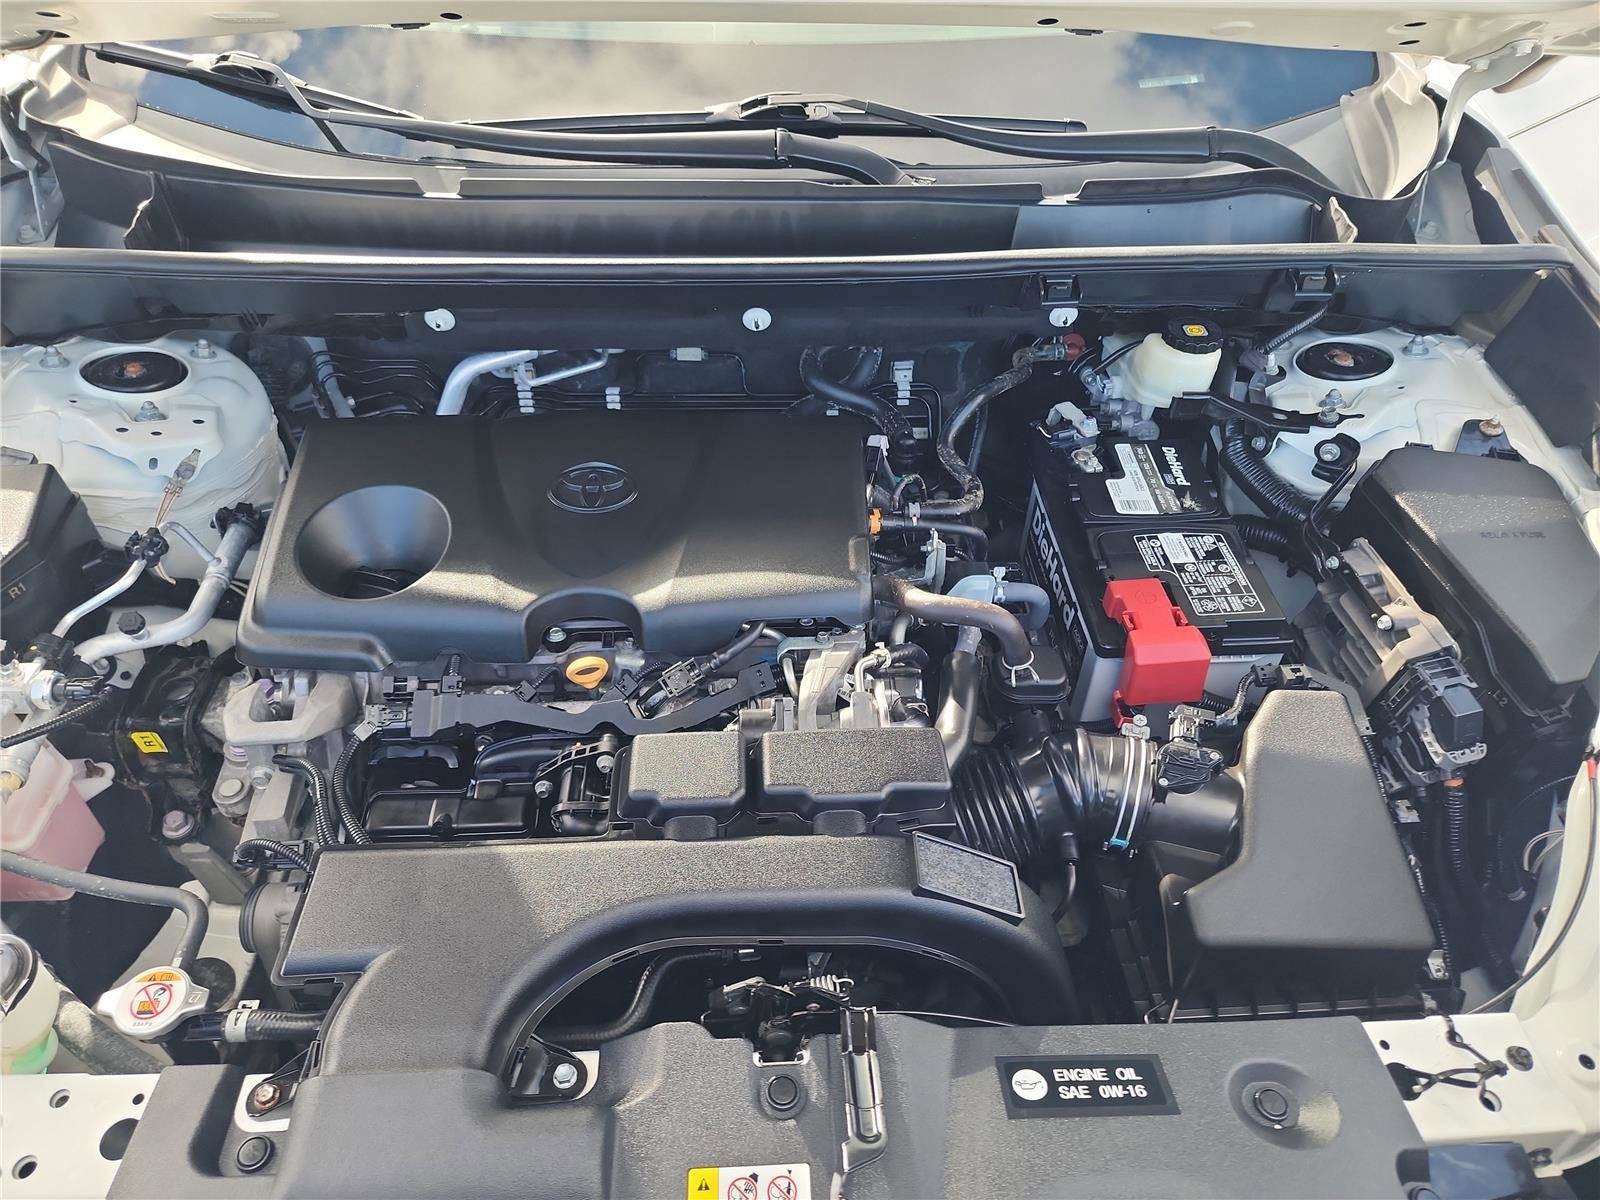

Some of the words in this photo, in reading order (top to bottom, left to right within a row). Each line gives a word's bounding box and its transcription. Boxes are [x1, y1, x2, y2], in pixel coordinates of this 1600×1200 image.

[1161, 446, 1192, 486] DieHard
[1032, 505, 1075, 631] DieHard
[8, 582, 26, 599] R1
[1052, 1068, 1110, 1082] ENGINE
[1115, 1067, 1143, 1081] OIL
[1058, 1085, 1092, 1100] SAE
[1099, 1084, 1148, 1098] 0W-16
